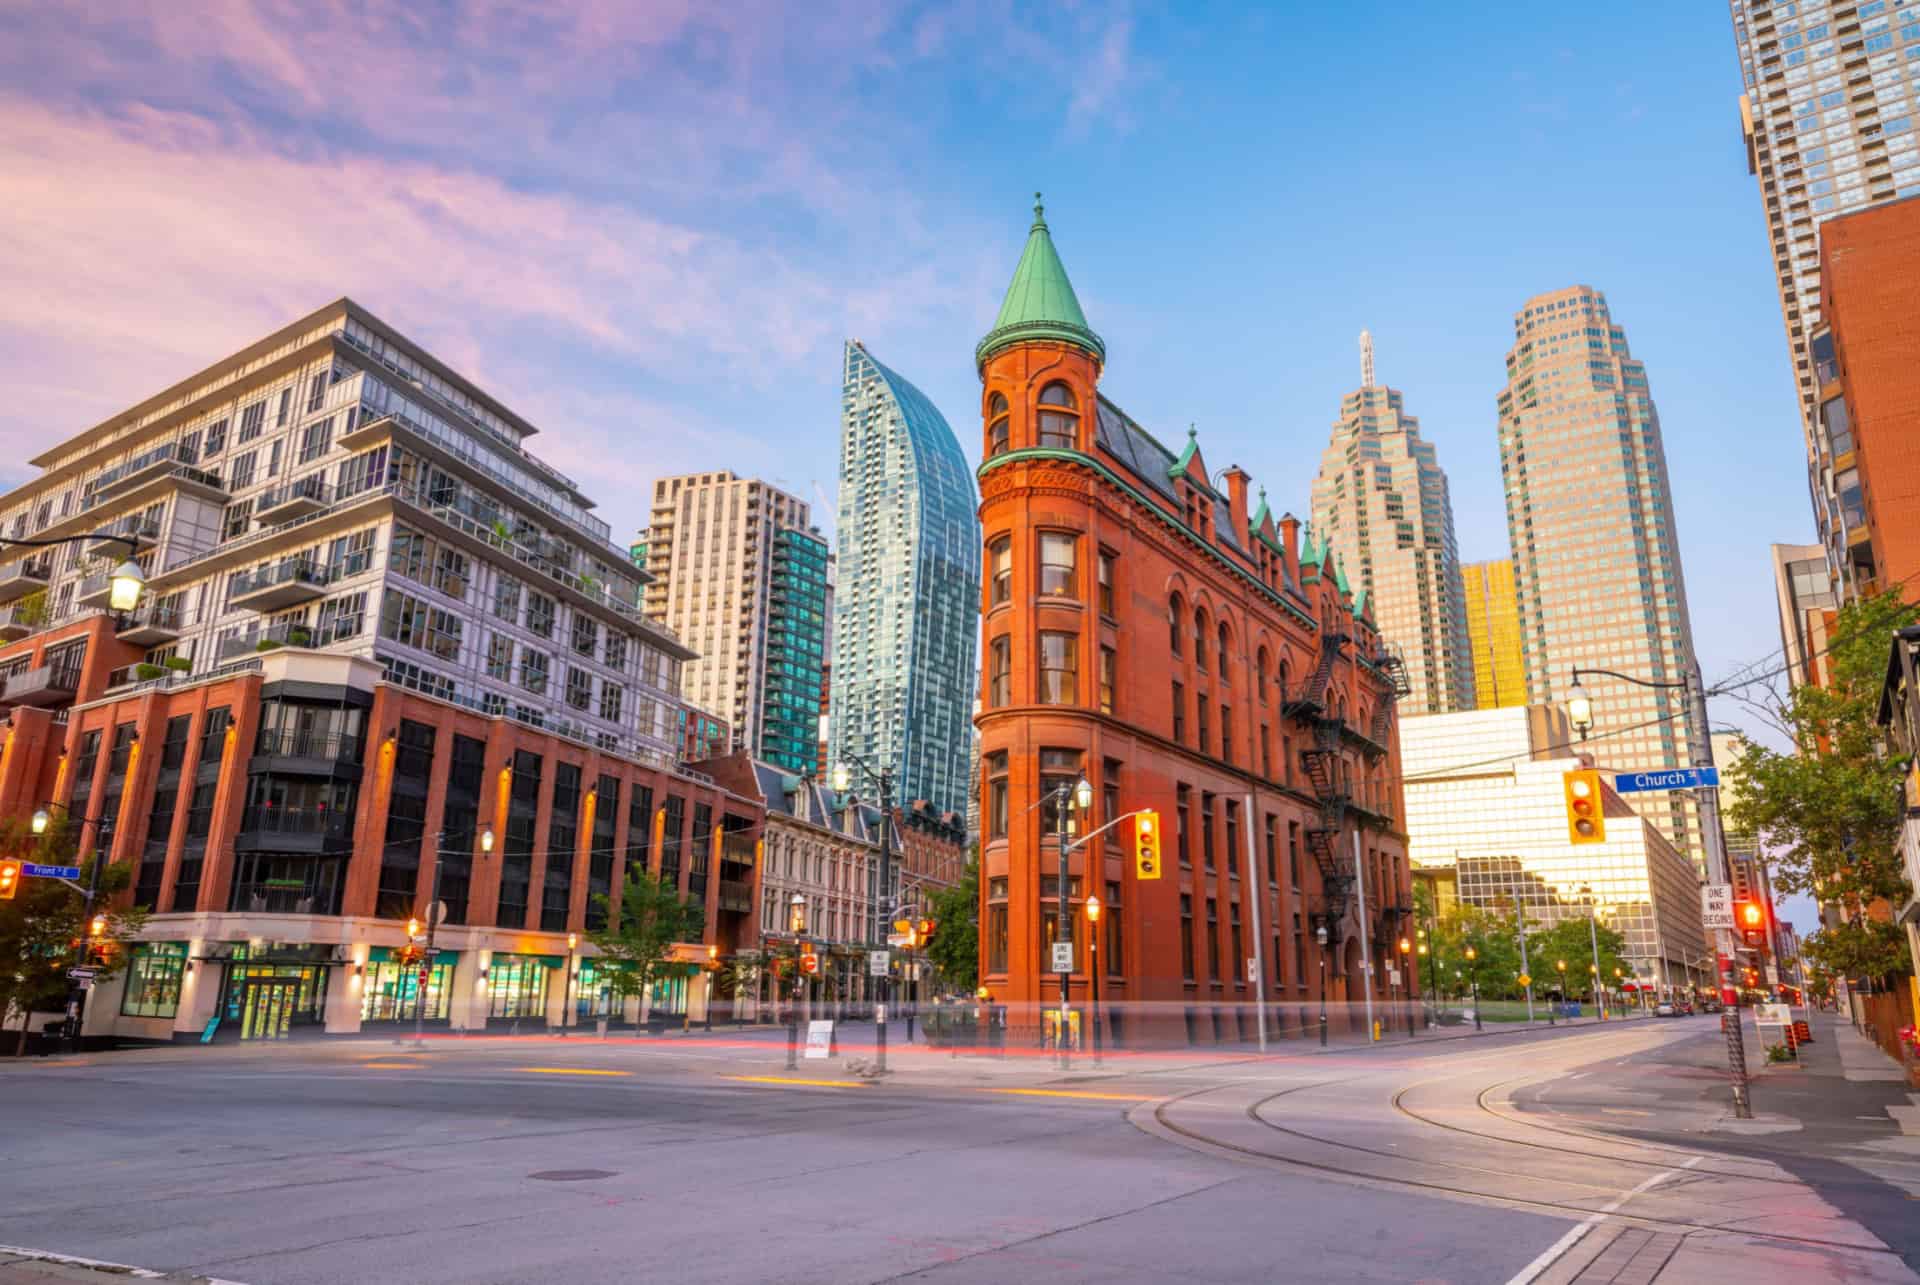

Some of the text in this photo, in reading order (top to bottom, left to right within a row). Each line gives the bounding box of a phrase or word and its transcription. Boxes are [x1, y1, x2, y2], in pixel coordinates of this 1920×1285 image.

[1635, 772, 1686, 787] Church
[33, 865, 57, 876] Front
[1708, 887, 1724, 898] ONE
[1708, 901, 1724, 911] WAY
[1703, 914, 1733, 925] BEGINS
